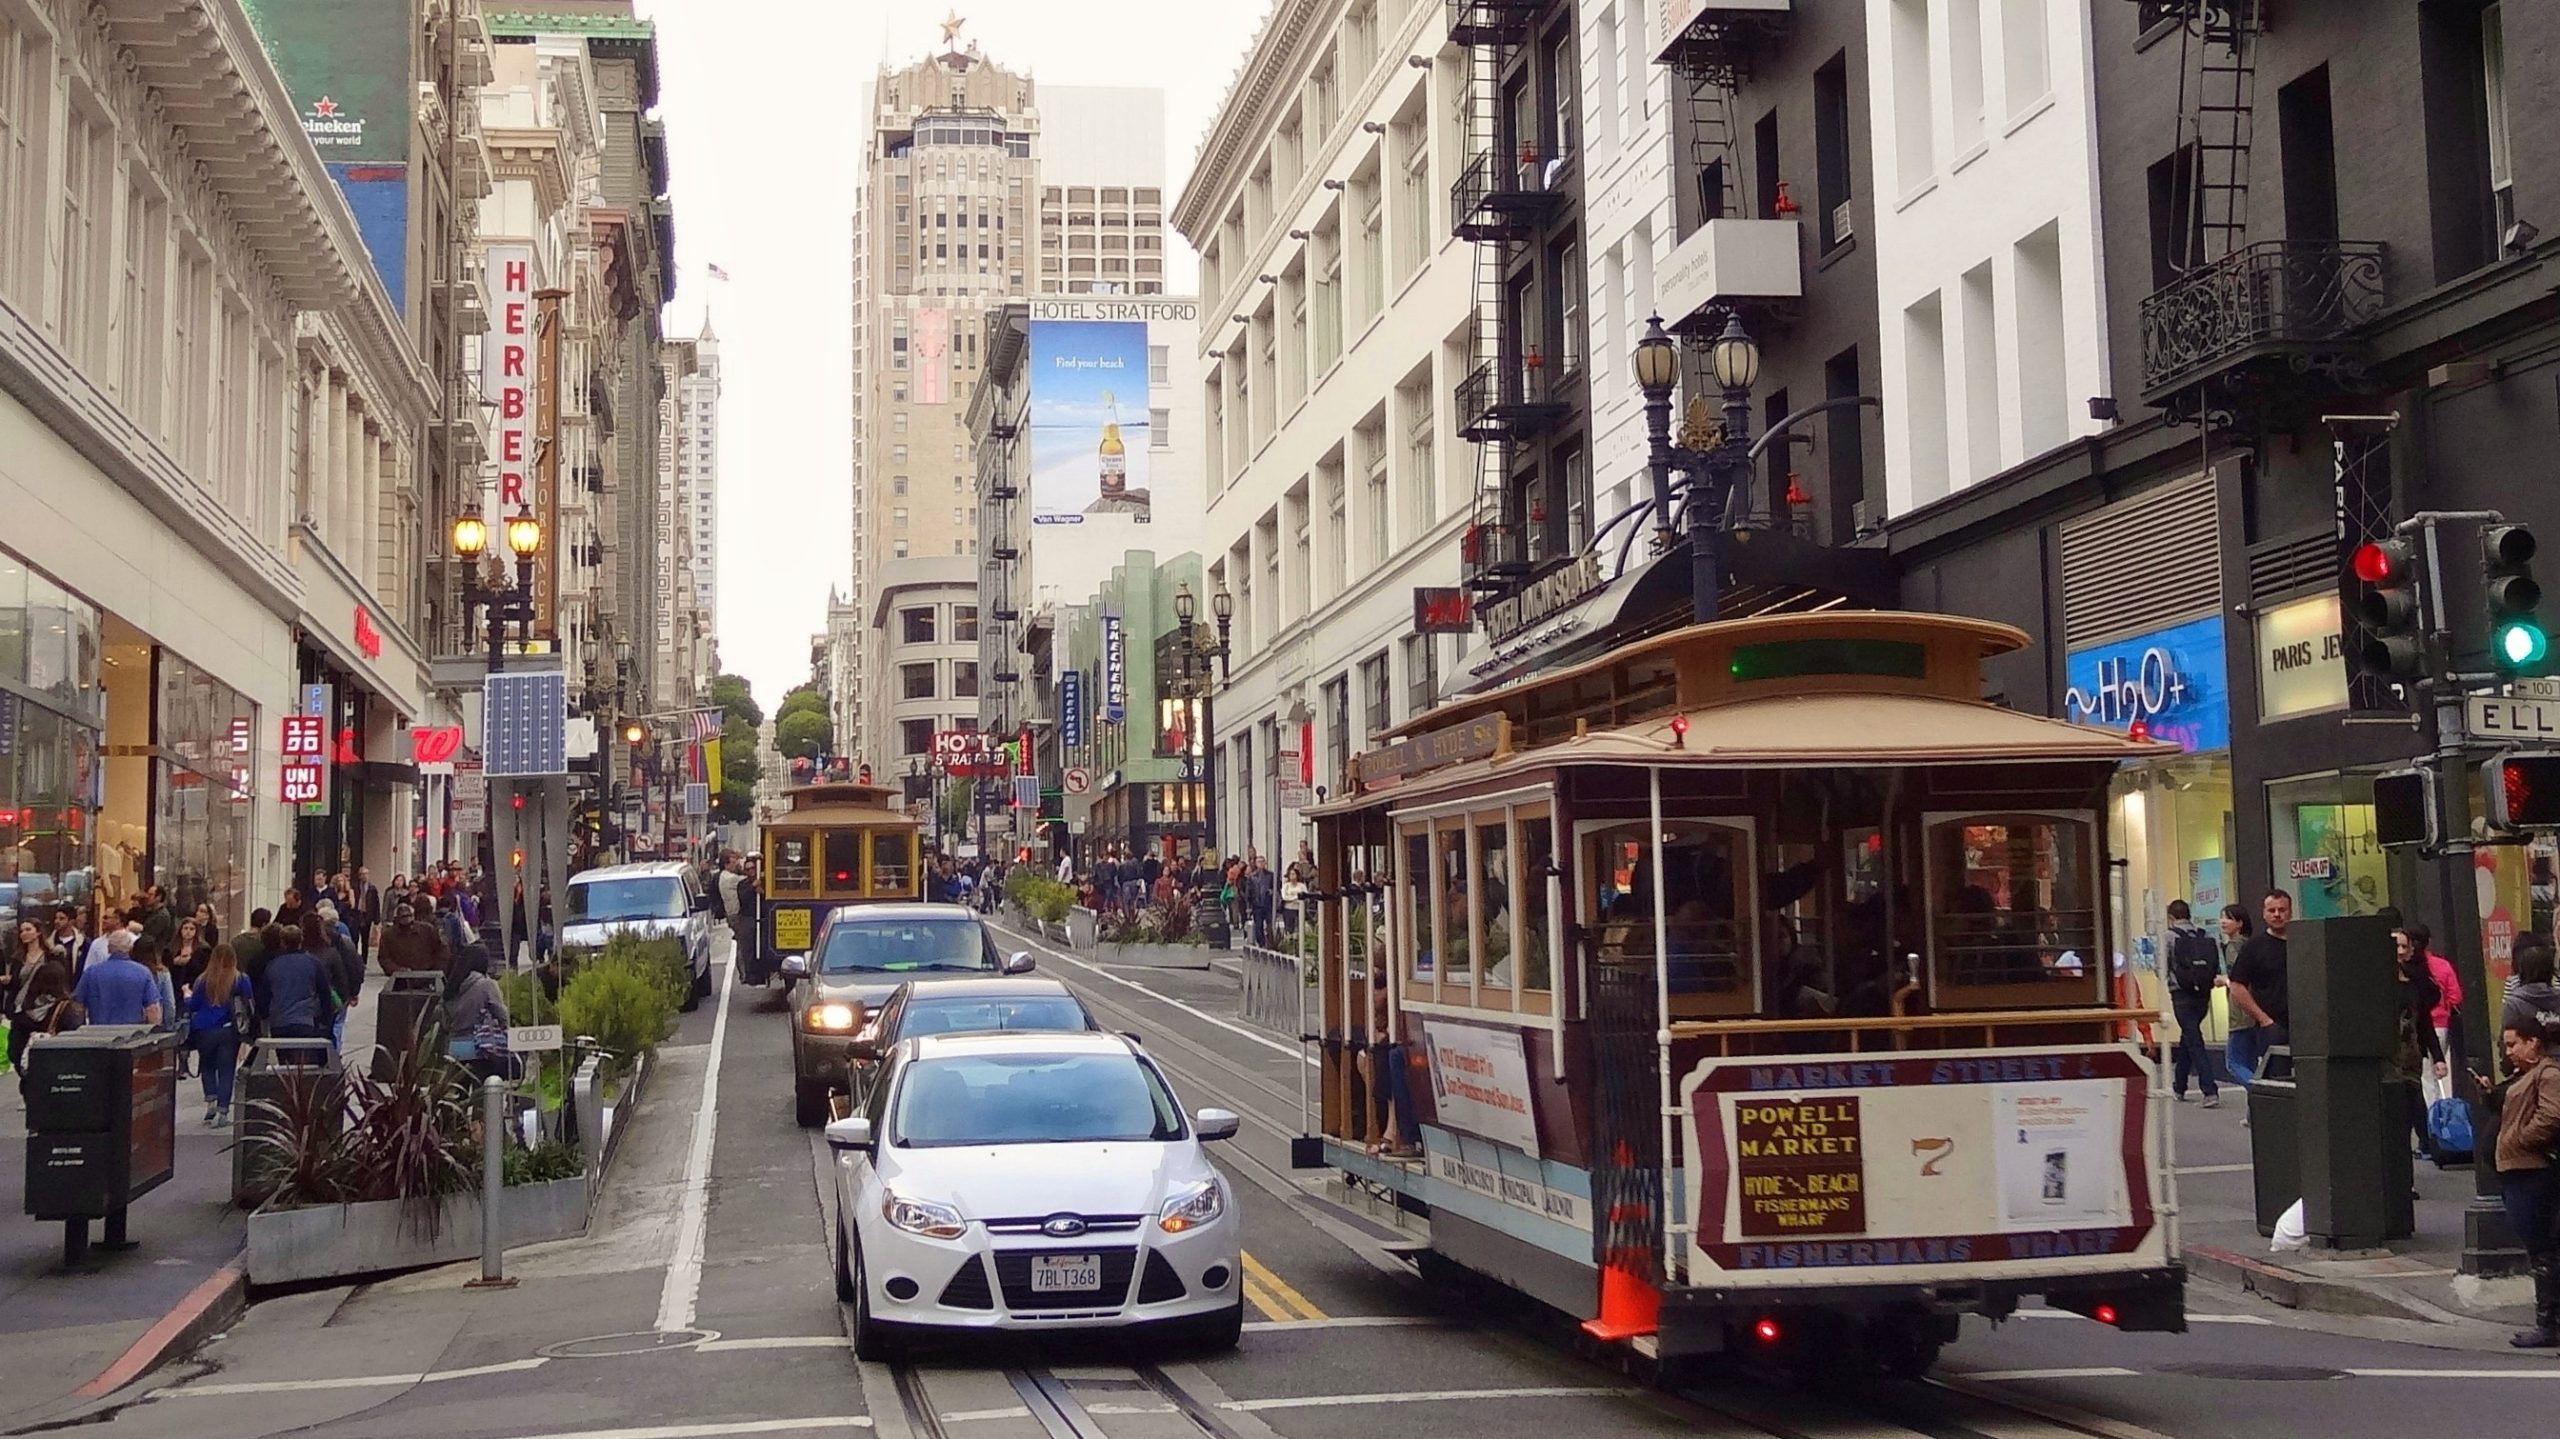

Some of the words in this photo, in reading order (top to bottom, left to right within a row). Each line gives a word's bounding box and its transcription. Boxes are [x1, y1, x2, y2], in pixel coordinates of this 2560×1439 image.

[301, 119, 362, 133] eineken
[314, 136, 334, 146] your
[336, 136, 361, 145] world
[1034, 303, 1091, 319] HOTEL
[1096, 303, 1197, 321] STRATFORD
[1056, 357, 1077, 369] Find
[1077, 360, 1098, 371] your
[1100, 357, 1124, 369] beach
[502, 261, 526, 522] HERBER
[2333, 441, 2345, 541] PARIS
[533, 436, 553, 621] FLORENCE
[656, 556, 672, 646] HOTEL
[1109, 620, 1122, 704] SKECHERS
[2272, 641, 2312, 672] PARIS
[2533, 682, 2553, 695] 100
[1433, 729, 1468, 759] HYDE
[285, 768, 315, 783] UNI
[285, 784, 318, 799] QLO
[2291, 860, 2309, 879] SALE
[1750, 1064, 1896, 1090] MARKET
[1931, 1057, 2066, 1084] STREET
[1741, 1105, 1854, 1125] POWELL
[1771, 1123, 1828, 1138] AND
[1740, 1136, 1857, 1157] MARKET
[1911, 1136, 1955, 1177] 7
[1744, 1176, 1785, 1196] HYDE
[1807, 1173, 1859, 1194] BEACH
[1754, 1197, 1850, 1214] FISHERMANS
[1776, 1212, 1829, 1227] WHARF
[1739, 1240, 1973, 1268] FISHERMANS
[2007, 1229, 2119, 1258] WHARF
[1037, 1268, 1096, 1287] 7BLT368
